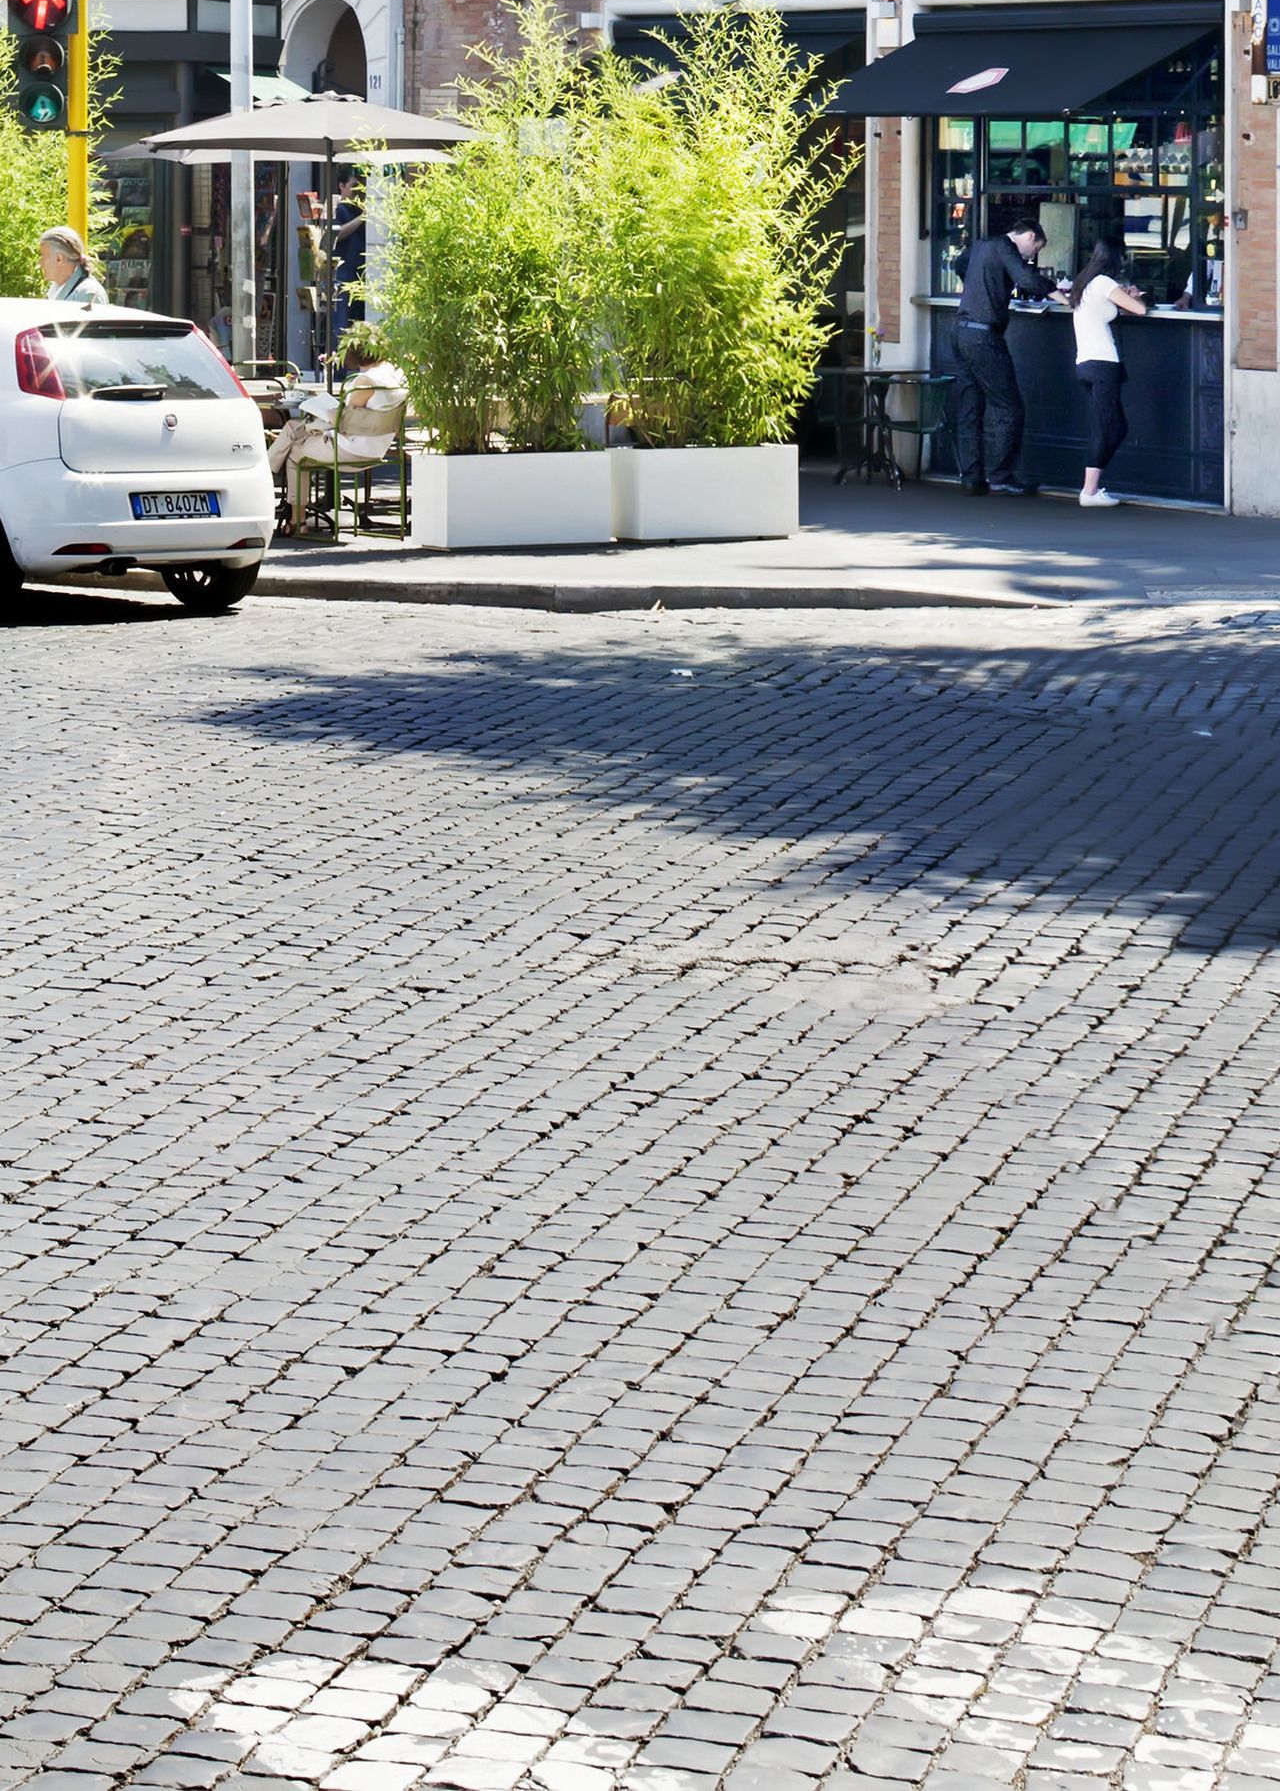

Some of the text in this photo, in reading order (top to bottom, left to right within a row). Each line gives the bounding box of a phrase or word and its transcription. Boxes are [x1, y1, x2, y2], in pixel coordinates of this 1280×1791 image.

[370, 75, 382, 89] 121
[142, 493, 210, 514] DT 840ZM
